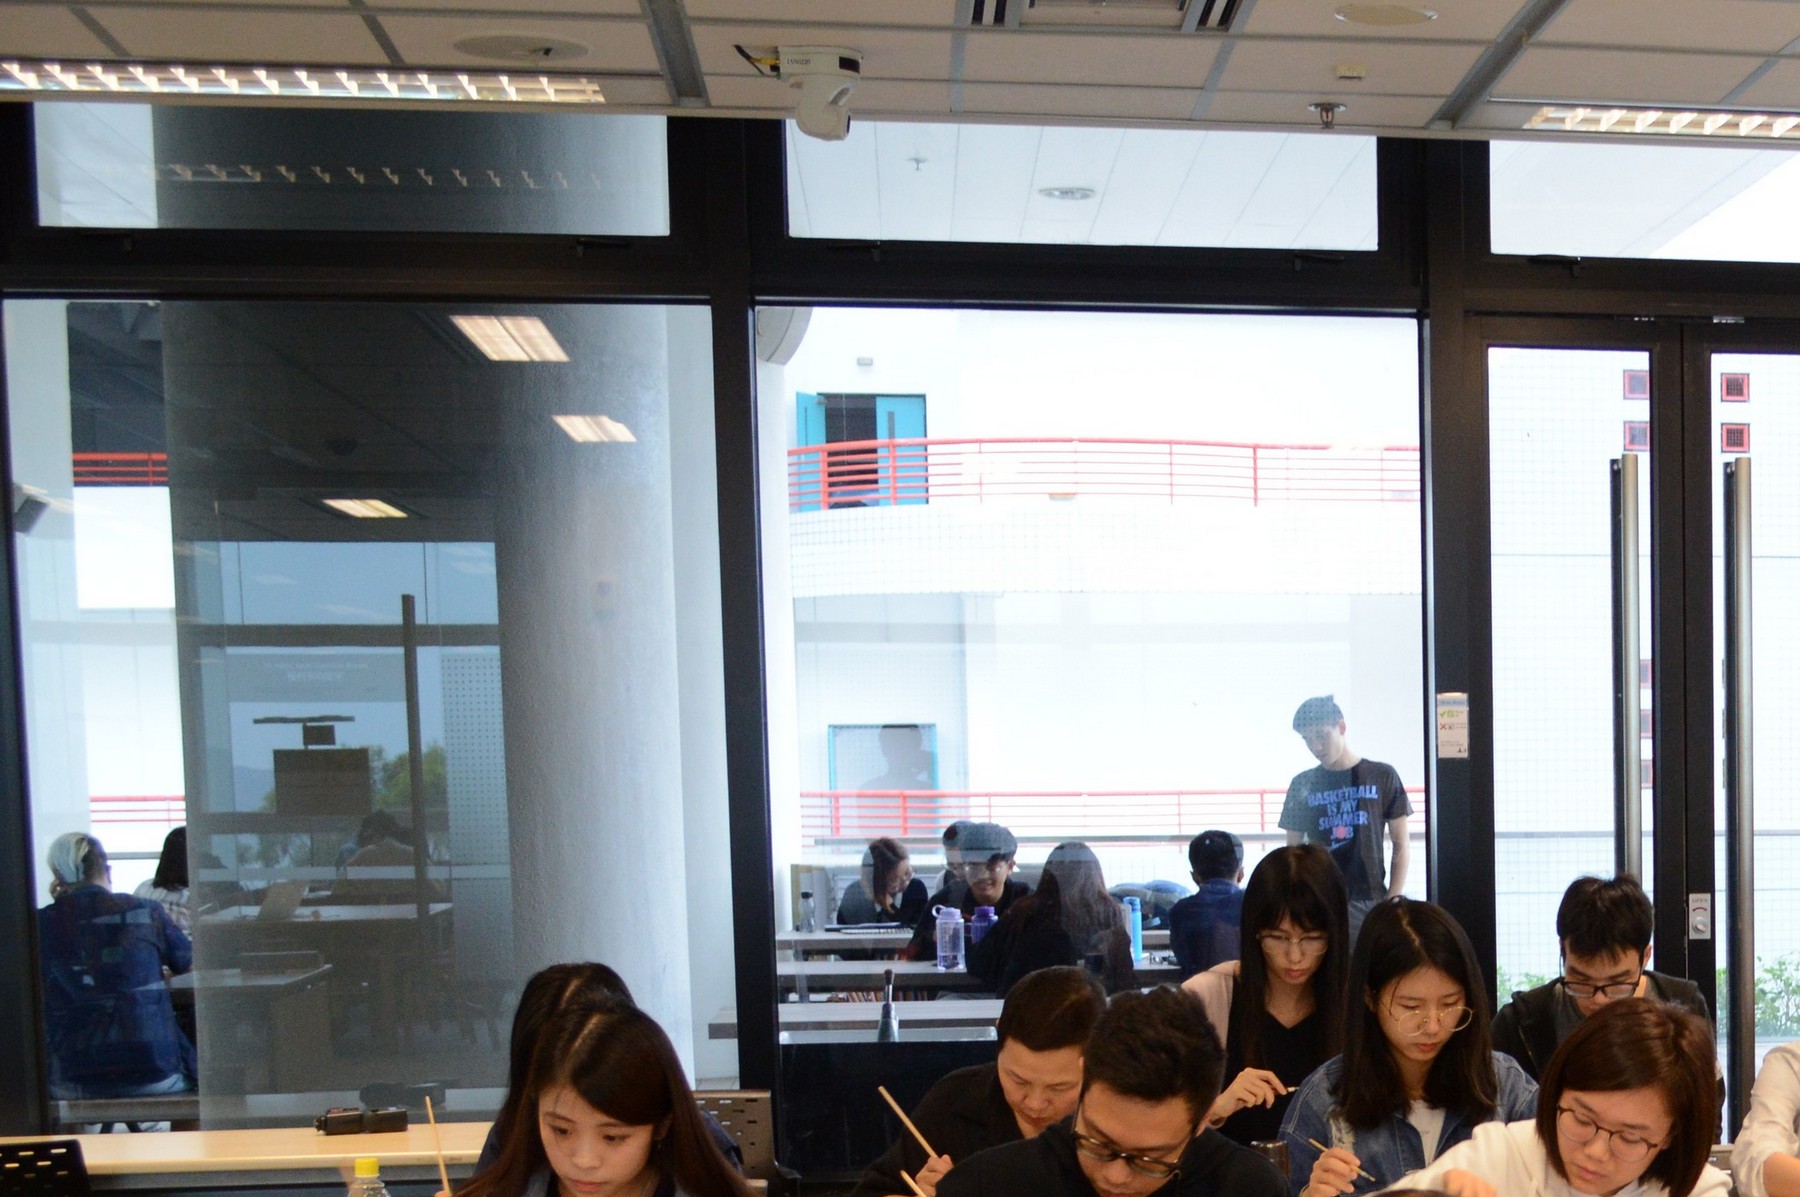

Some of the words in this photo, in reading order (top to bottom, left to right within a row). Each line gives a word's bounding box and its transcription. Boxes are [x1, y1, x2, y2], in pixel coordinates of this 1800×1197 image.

[1307, 785, 1378, 807] BASKETBALL
[1327, 802, 1338, 817] IS
[1340, 799, 1358, 814] MY
[1319, 811, 1368, 830] SUMMER
[1331, 826, 1354, 839] JOB
